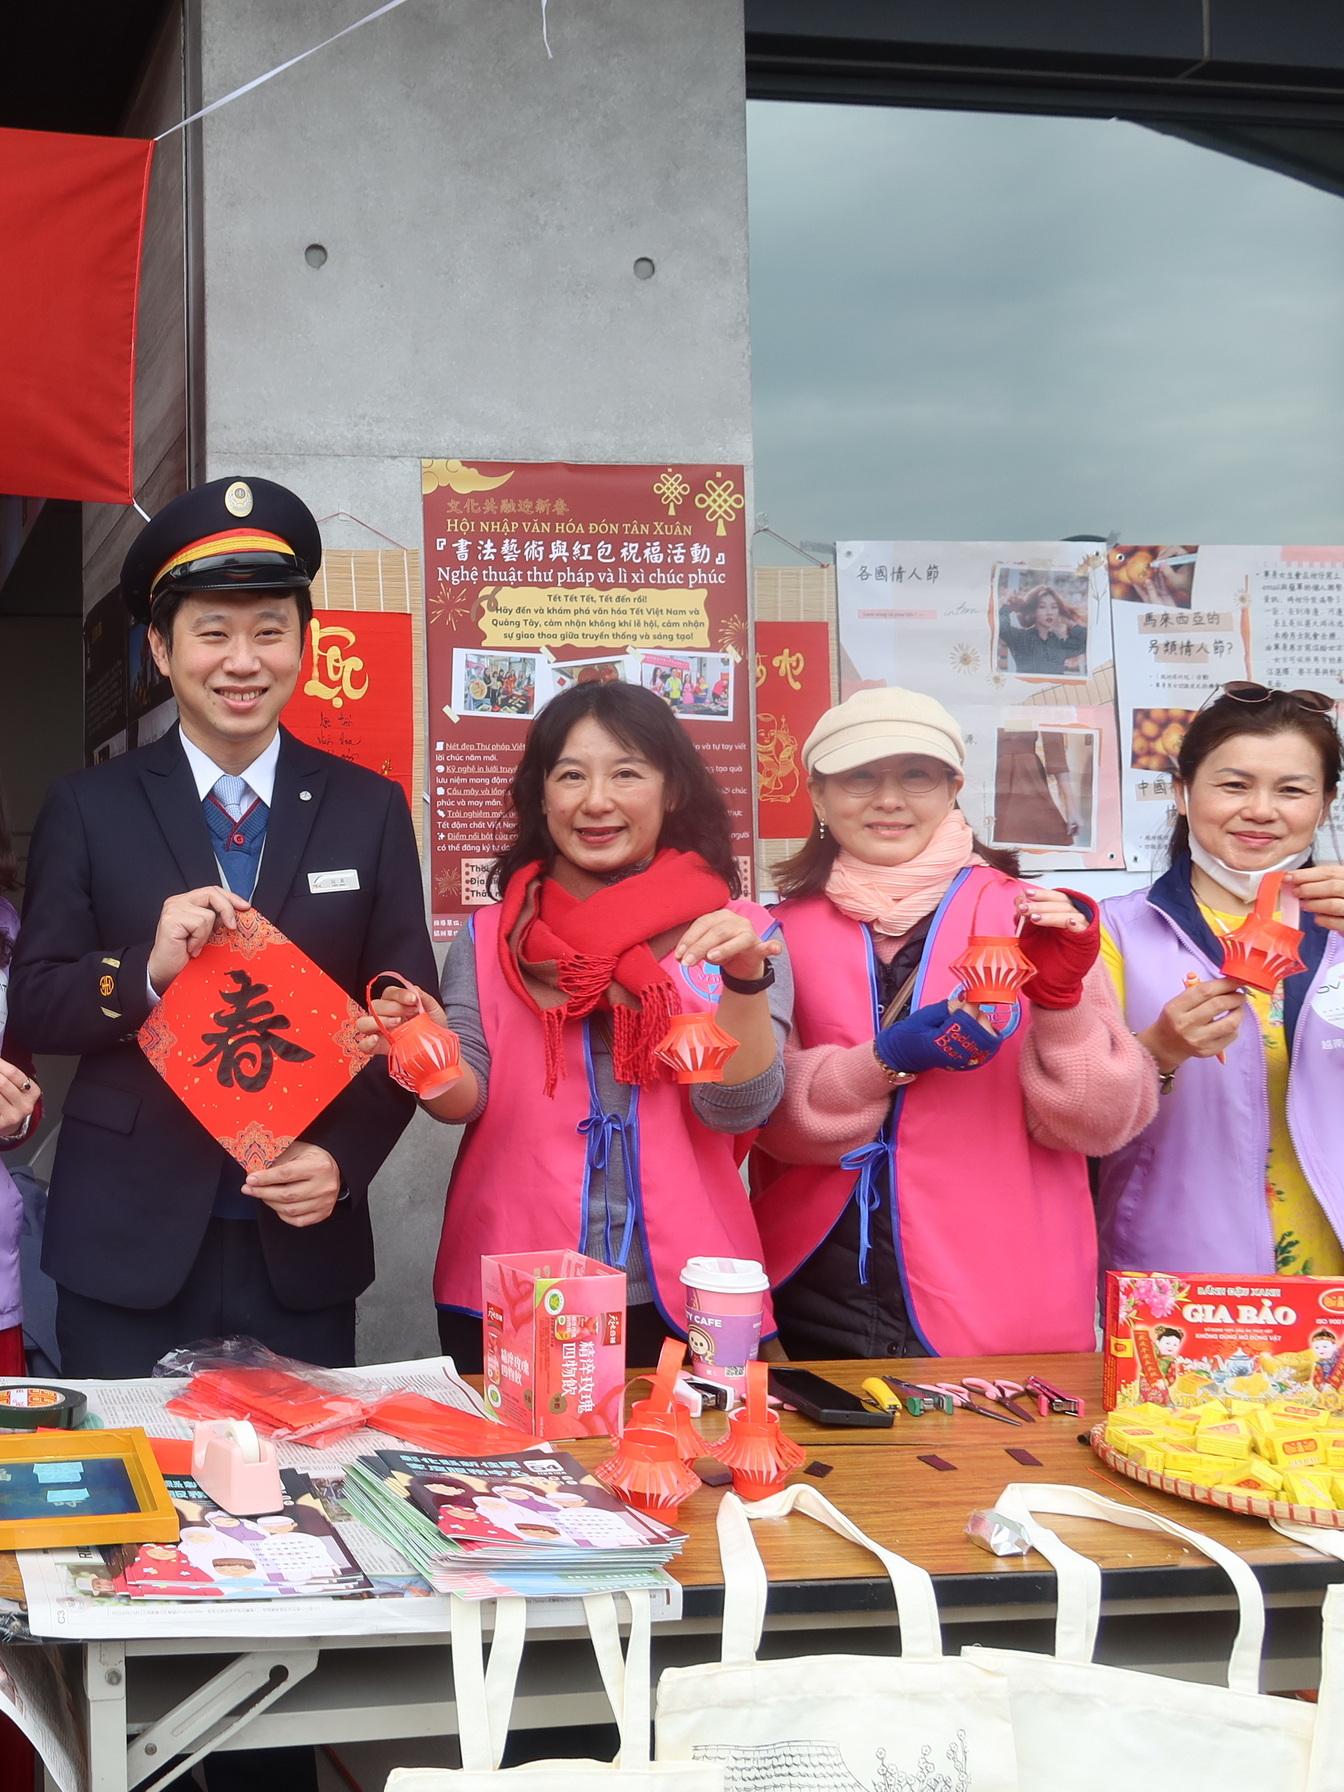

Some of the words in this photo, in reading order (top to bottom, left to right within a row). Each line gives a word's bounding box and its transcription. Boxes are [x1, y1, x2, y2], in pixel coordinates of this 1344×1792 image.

[437, 565, 479, 585] Nghệ
[482, 565, 524, 585] thuật
[527, 566, 553, 582] thư
[557, 566, 594, 587] pháp
[598, 568, 614, 583] và
[618, 567, 628, 583] lì
[632, 568, 645, 583] xì
[649, 567, 684, 584] chúc
[688, 568, 726, 588] phúc
[856, 564, 940, 584] 各國情人節
[1143, 611, 1220, 628] 馬來西亞的
[193, 969, 316, 1093] 春
[694, 1315, 723, 1328] CAFE
[1182, 1304, 1234, 1324] GIA
[1237, 1298, 1297, 1325] BẢO
[561, 1342, 578, 1397] 四物飲
[578, 1341, 596, 1414] 精淬玫瑰
